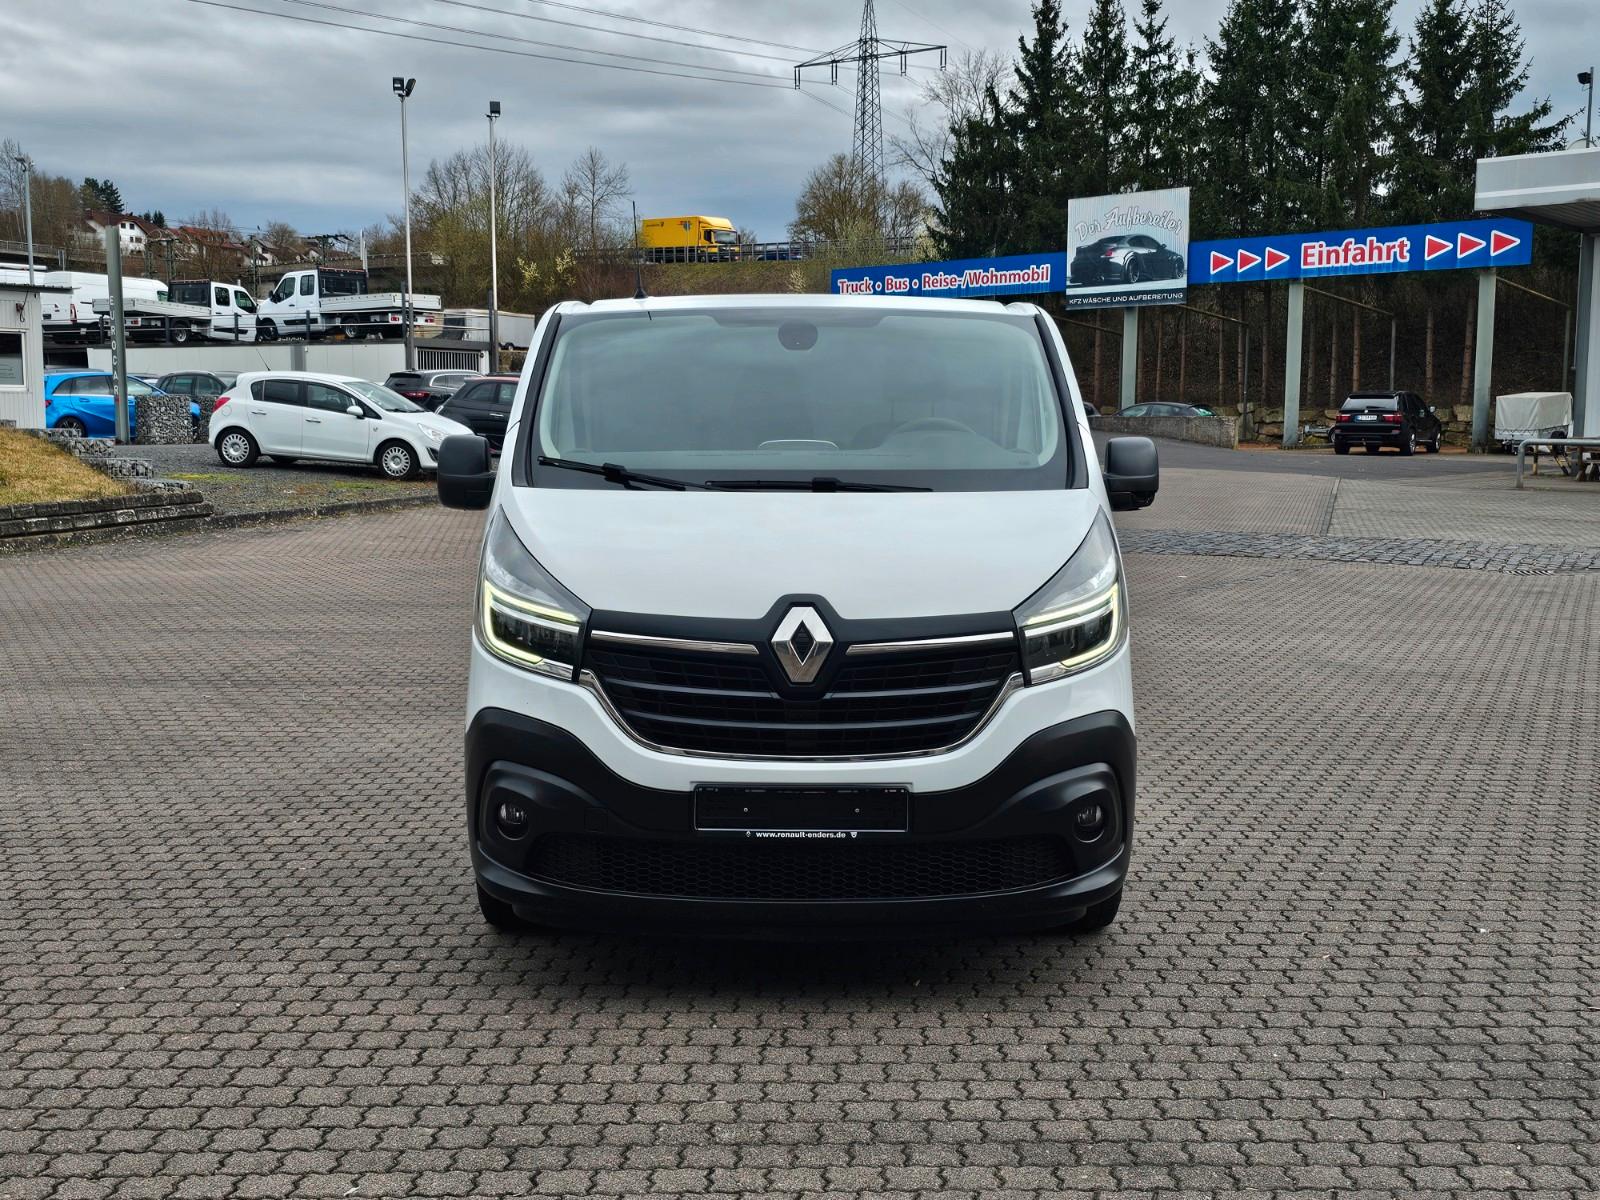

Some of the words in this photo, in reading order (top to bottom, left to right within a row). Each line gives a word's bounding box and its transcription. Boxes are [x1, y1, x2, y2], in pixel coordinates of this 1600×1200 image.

[1075, 220, 1102, 241] Der
[1103, 206, 1183, 234] Aufbereiter
[1301, 236, 1411, 269] Einfahrt
[838, 277, 873, 295] Truck
[885, 275, 909, 292] Bus
[1083, 296, 1111, 304] WÄSCHE
[1128, 292, 1184, 302] AUFBEREITUNG
